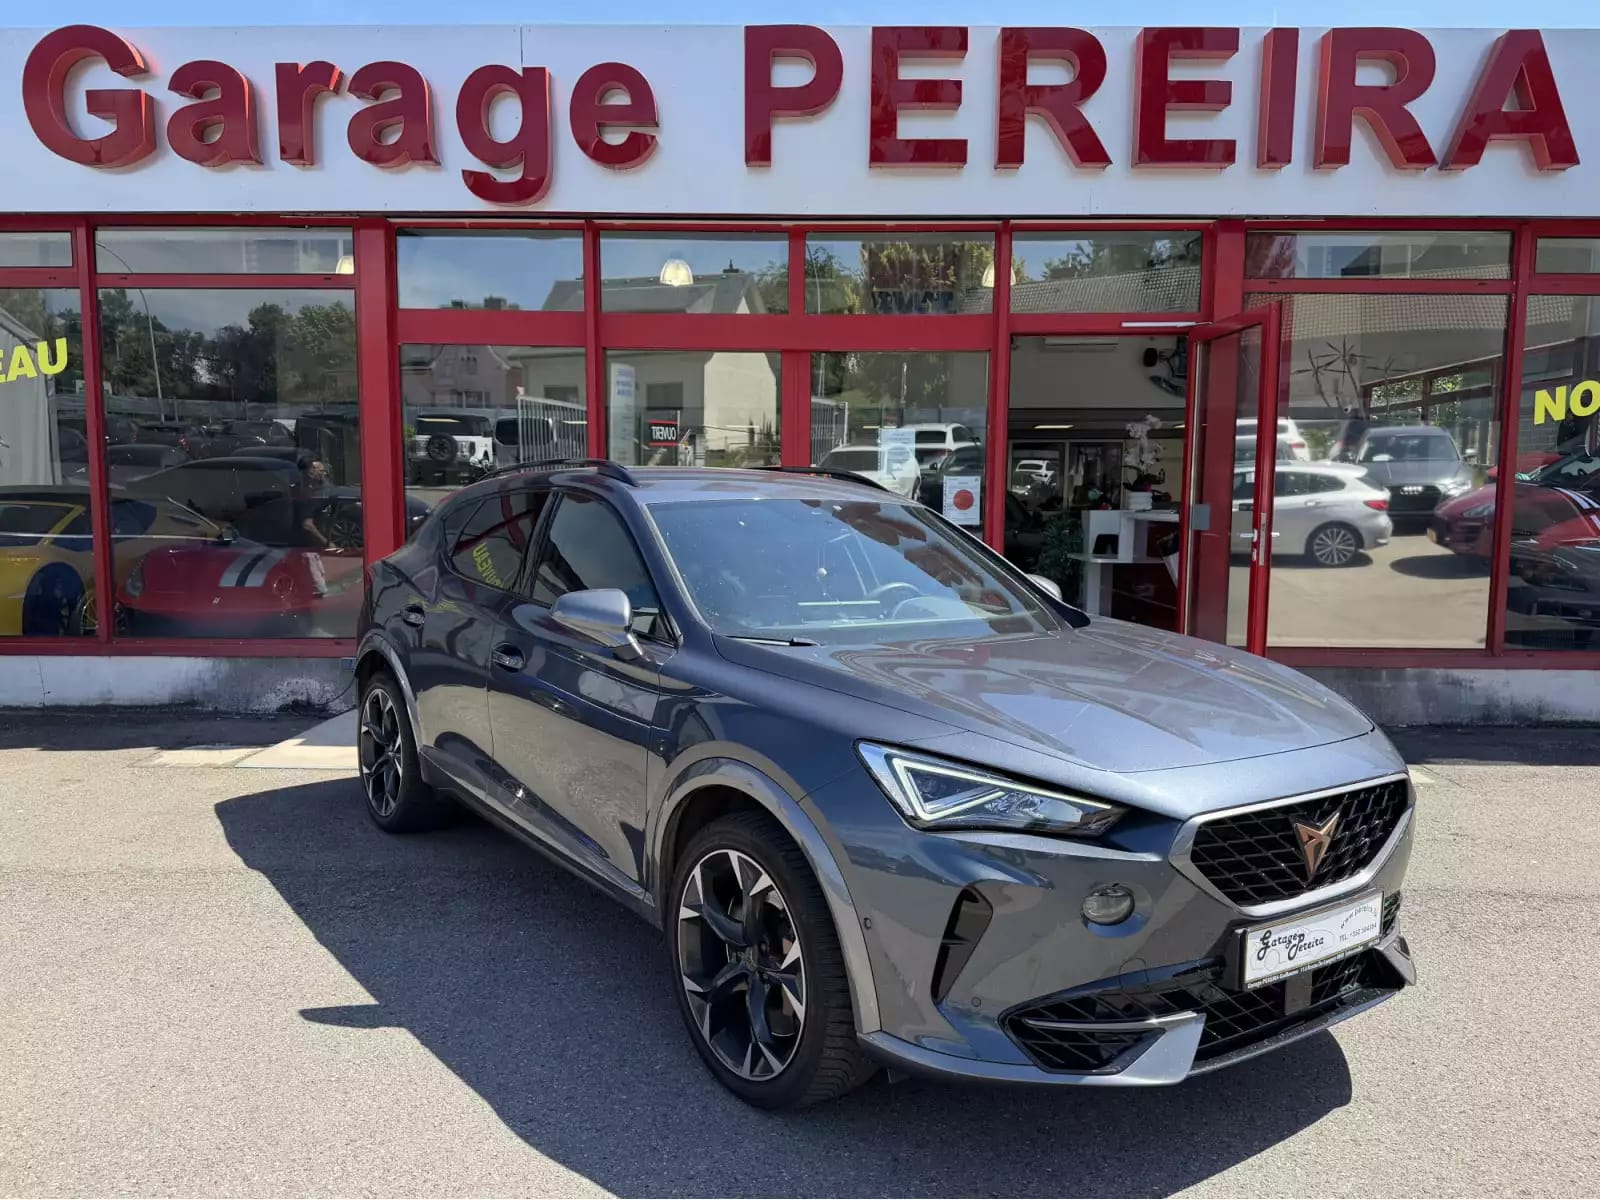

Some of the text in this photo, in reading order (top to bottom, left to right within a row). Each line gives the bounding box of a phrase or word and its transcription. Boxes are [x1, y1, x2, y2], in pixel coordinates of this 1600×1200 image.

[22, 25, 1581, 206] Garage PEREIRA
[0, 336, 68, 384] AU
[1257, 929, 1298, 961] Garage
